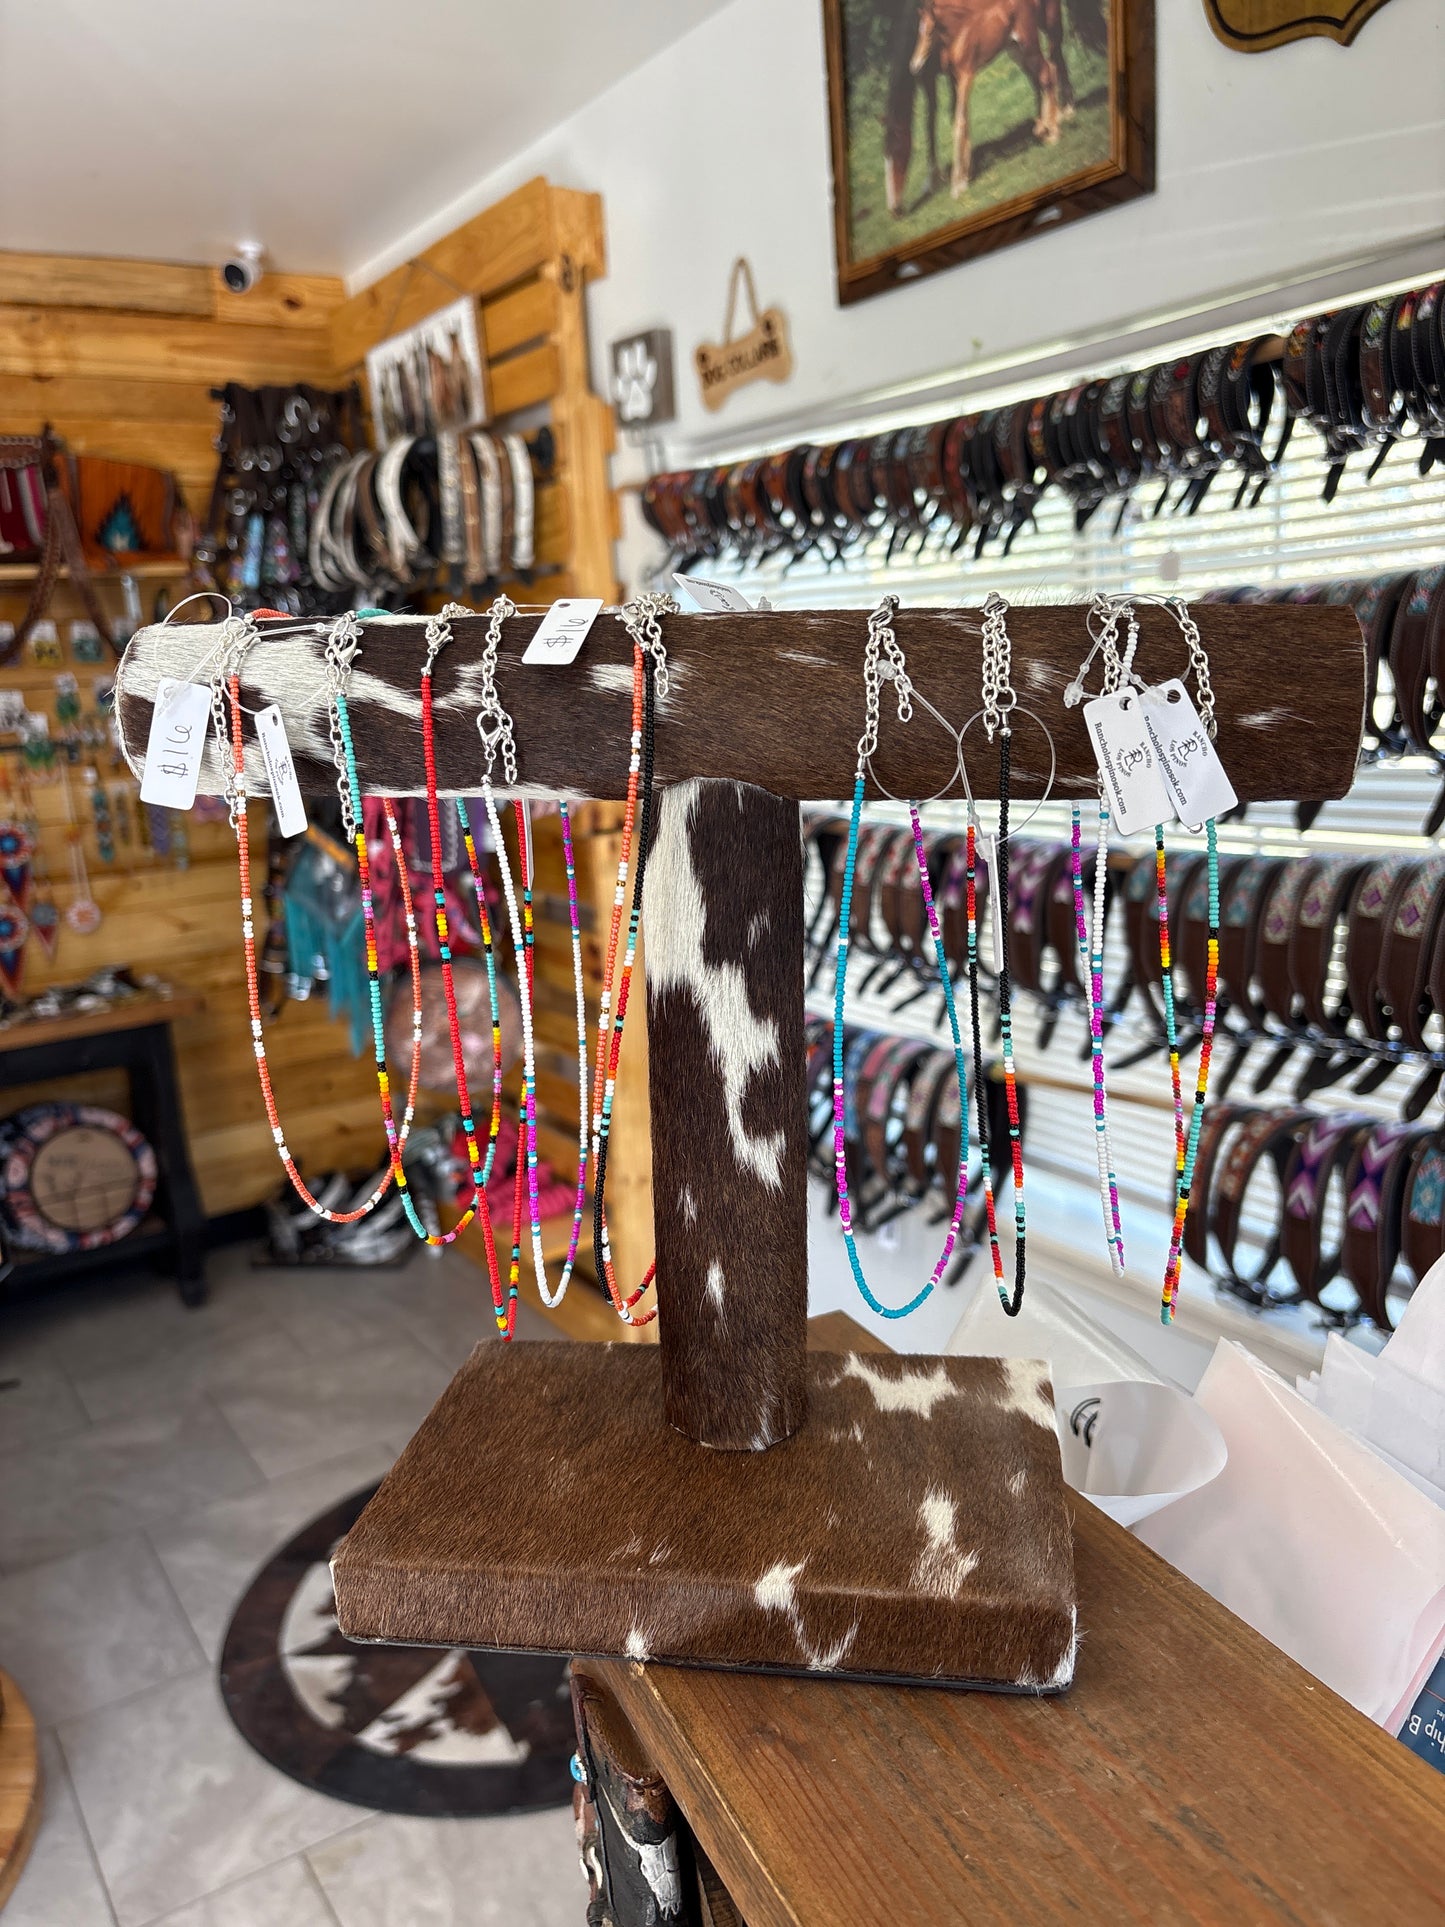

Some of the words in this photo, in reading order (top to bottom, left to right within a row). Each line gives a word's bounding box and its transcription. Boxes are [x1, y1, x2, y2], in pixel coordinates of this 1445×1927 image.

[543, 618, 589, 648] $16
[157, 725, 193, 778] $16
[1116, 748, 1125, 761] LOS
[1139, 741, 1152, 768] RANCHO
[1169, 739, 1178, 752] LOS
[1192, 730, 1208, 757] RANCHO
[1094, 721, 1127, 815] Rancholospinosok.com
[1170, 753, 1187, 767] PINOS
[1424, 1719, 1445, 1753] hip
